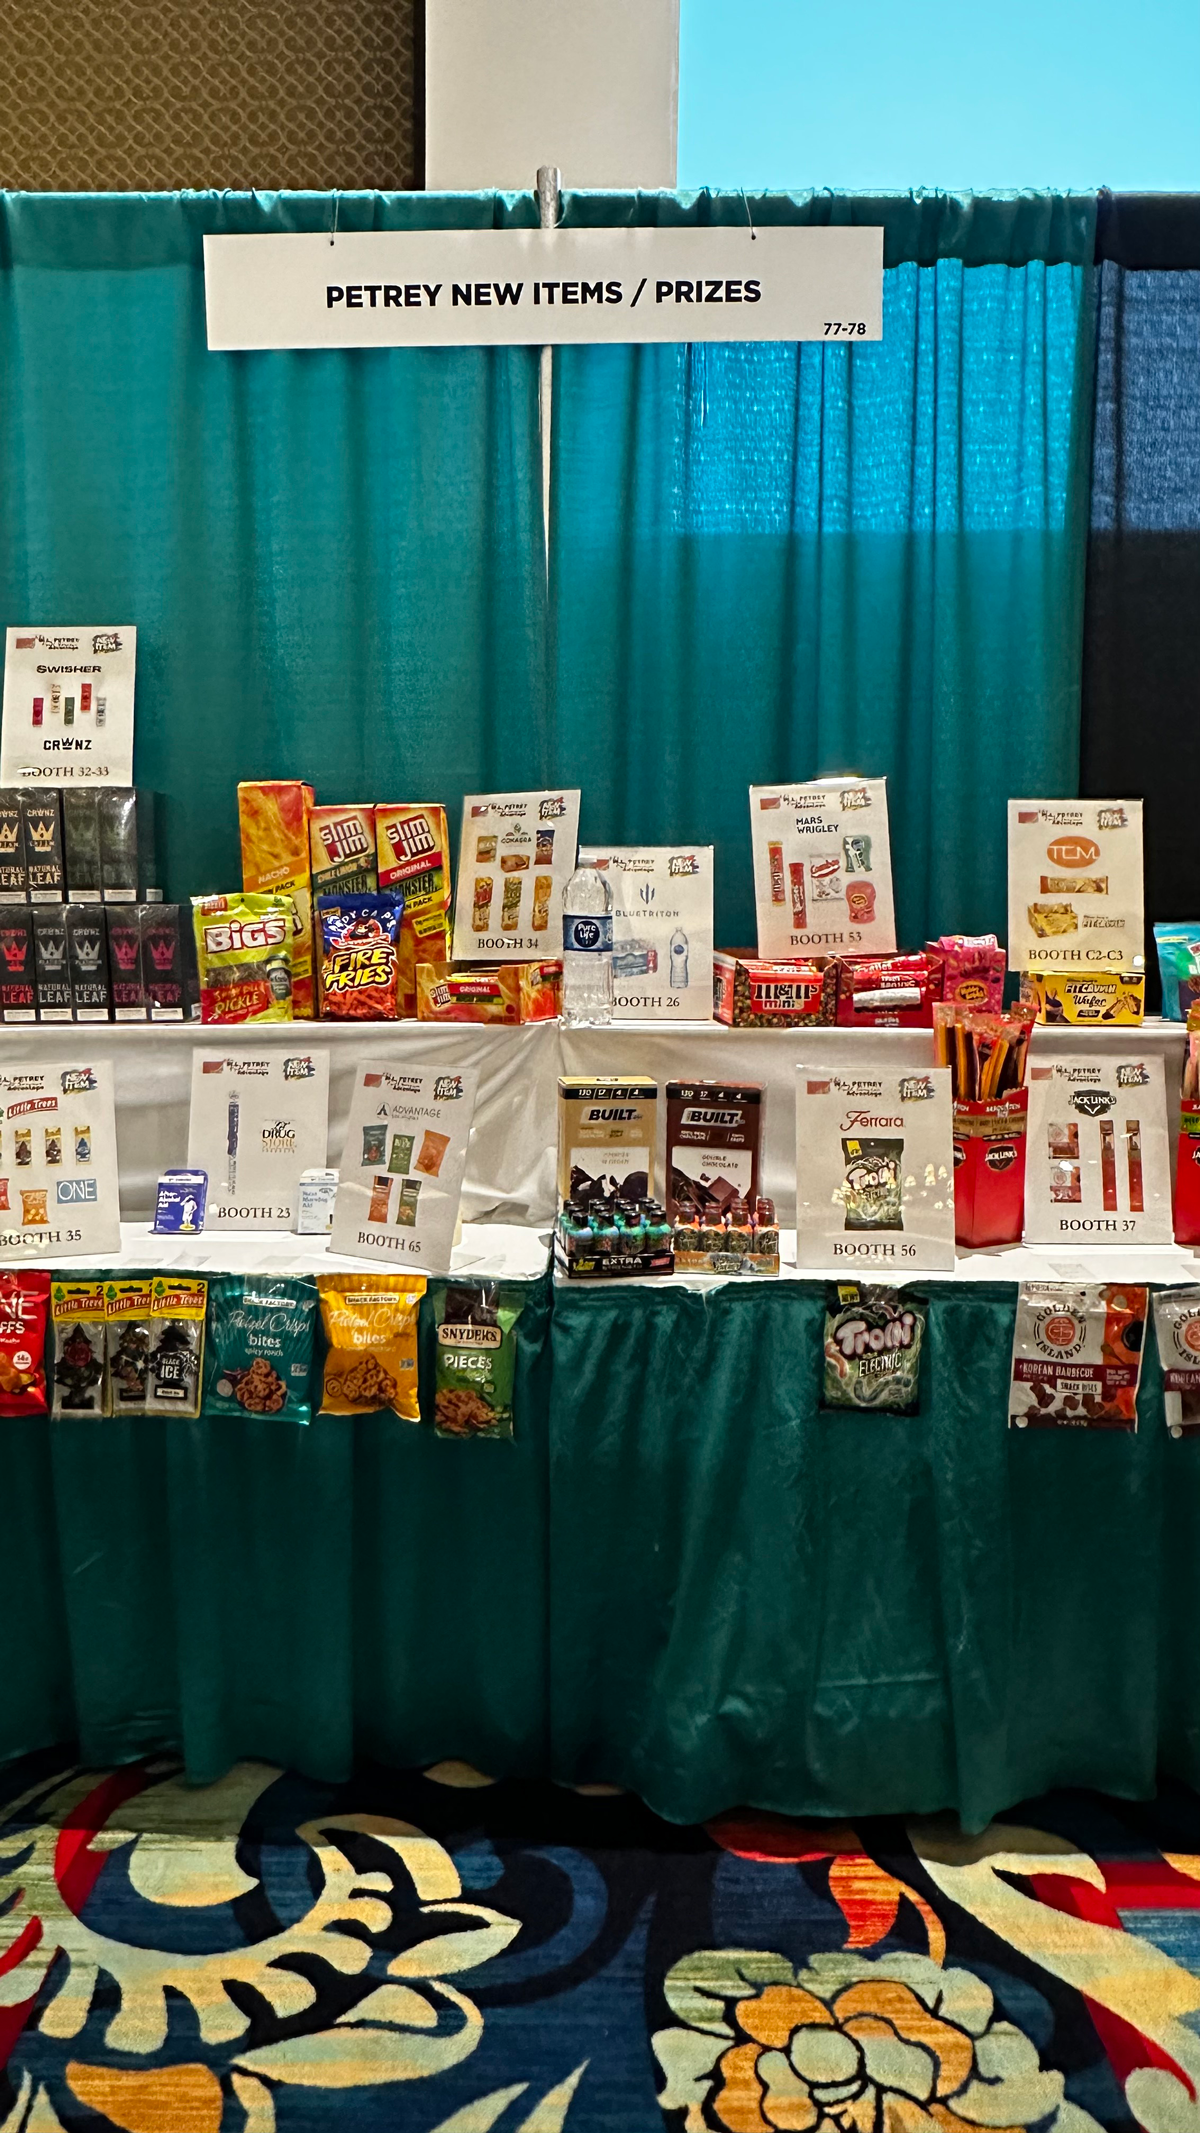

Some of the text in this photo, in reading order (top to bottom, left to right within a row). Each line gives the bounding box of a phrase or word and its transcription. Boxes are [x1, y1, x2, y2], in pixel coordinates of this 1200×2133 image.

[326, 279, 761, 309] PETREY NEW ITEMS / PRIZES
[823, 321, 867, 337] 77-78
[36, 664, 102, 674] SWISHER
[78, 766, 110, 778] 32-33
[796, 816, 822, 826] MARS
[797, 825, 839, 834] WRIGLEY
[1048, 845, 1100, 860] TCM
[28, 865, 60, 875] NATURAL
[258, 867, 291, 884] NACHO
[389, 860, 431, 879] ORIGINAL
[0, 873, 26, 886] EAF
[30, 873, 62, 886] LEAF
[275, 880, 296, 893] PACK
[412, 896, 433, 909] PACK
[578, 923, 596, 932] Pure
[478, 937, 539, 949] BOOTH 34
[790, 932, 862, 946] BOOTH 53
[335, 948, 393, 974] FIRE
[1028, 949, 1124, 962] BOOTH C2-C3
[325, 965, 391, 990] FRIES
[459, 985, 490, 993] ORIGINAL
[39, 991, 71, 1003] LEAF
[75, 991, 108, 1003] LEAF
[214, 992, 260, 1014] PICKLE
[612, 996, 680, 1007] BOOTH 26
[763, 998, 804, 1010] minis
[393, 1105, 442, 1119] ADVANTAGE
[588, 1108, 637, 1121] BUILT
[690, 1110, 738, 1124] BUILT
[840, 1110, 904, 1131] Ferrara
[262, 1129, 296, 1139] DRUG
[262, 1138, 296, 1148] STORE
[58, 1181, 96, 1201] ONE
[217, 1206, 291, 1219] BOOTH 23
[1059, 1219, 1136, 1232] BOOTH 37
[66, 1230, 82, 1241] 35
[357, 1231, 422, 1253] BOOTH 65
[833, 1243, 916, 1257] BOOTH 56
[602, 1257, 643, 1265] EXTRA
[96, 1286, 104, 1296] 2
[196, 1282, 205, 1295] 2
[0, 1289, 39, 1320] NE
[108, 1299, 131, 1315] Little
[153, 1295, 178, 1311] Little
[347, 1296, 367, 1304] SNACK
[55, 1300, 78, 1316] Little
[1037, 1304, 1087, 1324] GOLDEN
[0, 1321, 26, 1335] FFS
[442, 1327, 498, 1342] SNYDER'S
[836, 1312, 915, 1356] Trolli
[249, 1333, 282, 1348] bites
[353, 1331, 387, 1345] bites
[1036, 1341, 1082, 1360] ISLAND
[444, 1354, 493, 1370] PIECES
[161, 1365, 180, 1379] ICE
[1023, 1362, 1054, 1376] KOREAN
[1055, 1364, 1095, 1379] BARBECUE
[1060, 1381, 1080, 1391] SNACK
